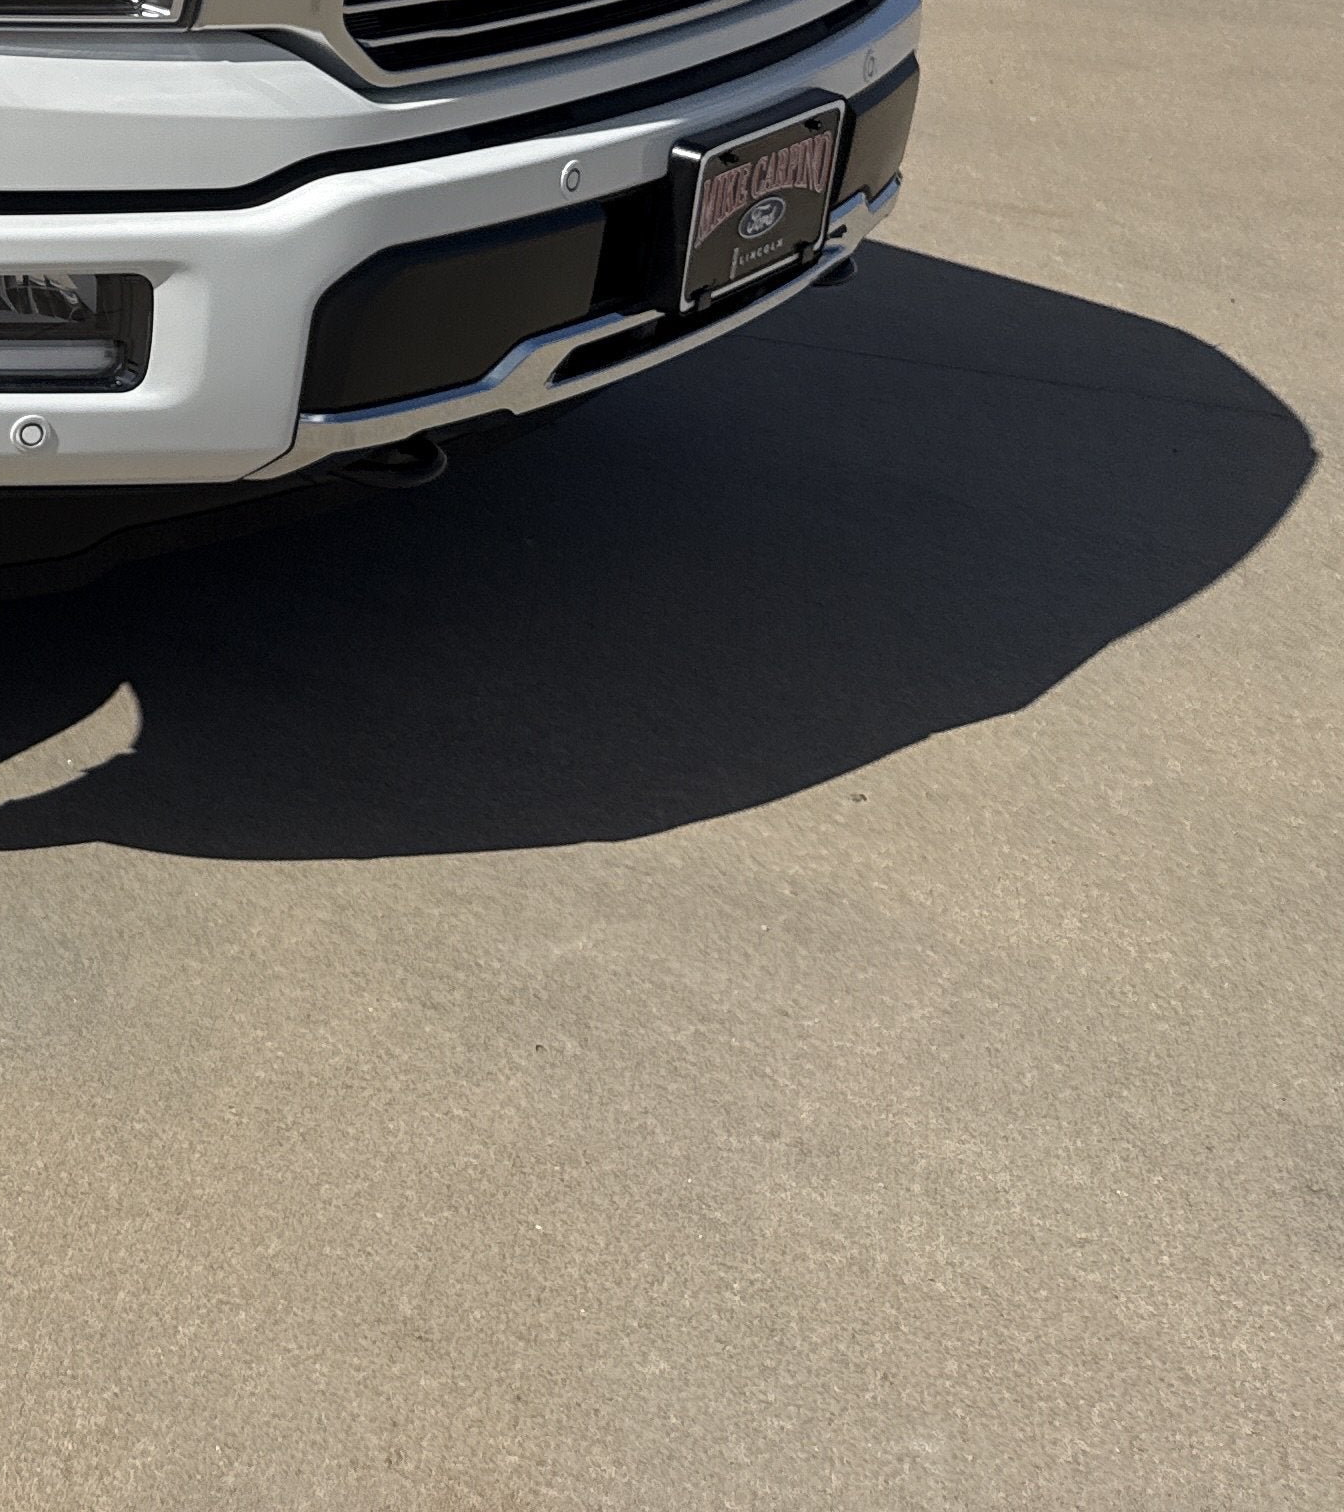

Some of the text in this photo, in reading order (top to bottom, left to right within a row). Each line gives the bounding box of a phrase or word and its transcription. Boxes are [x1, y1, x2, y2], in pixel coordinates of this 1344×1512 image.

[694, 130, 833, 249] MIKE CARPINO
[746, 205, 777, 235] Ford
